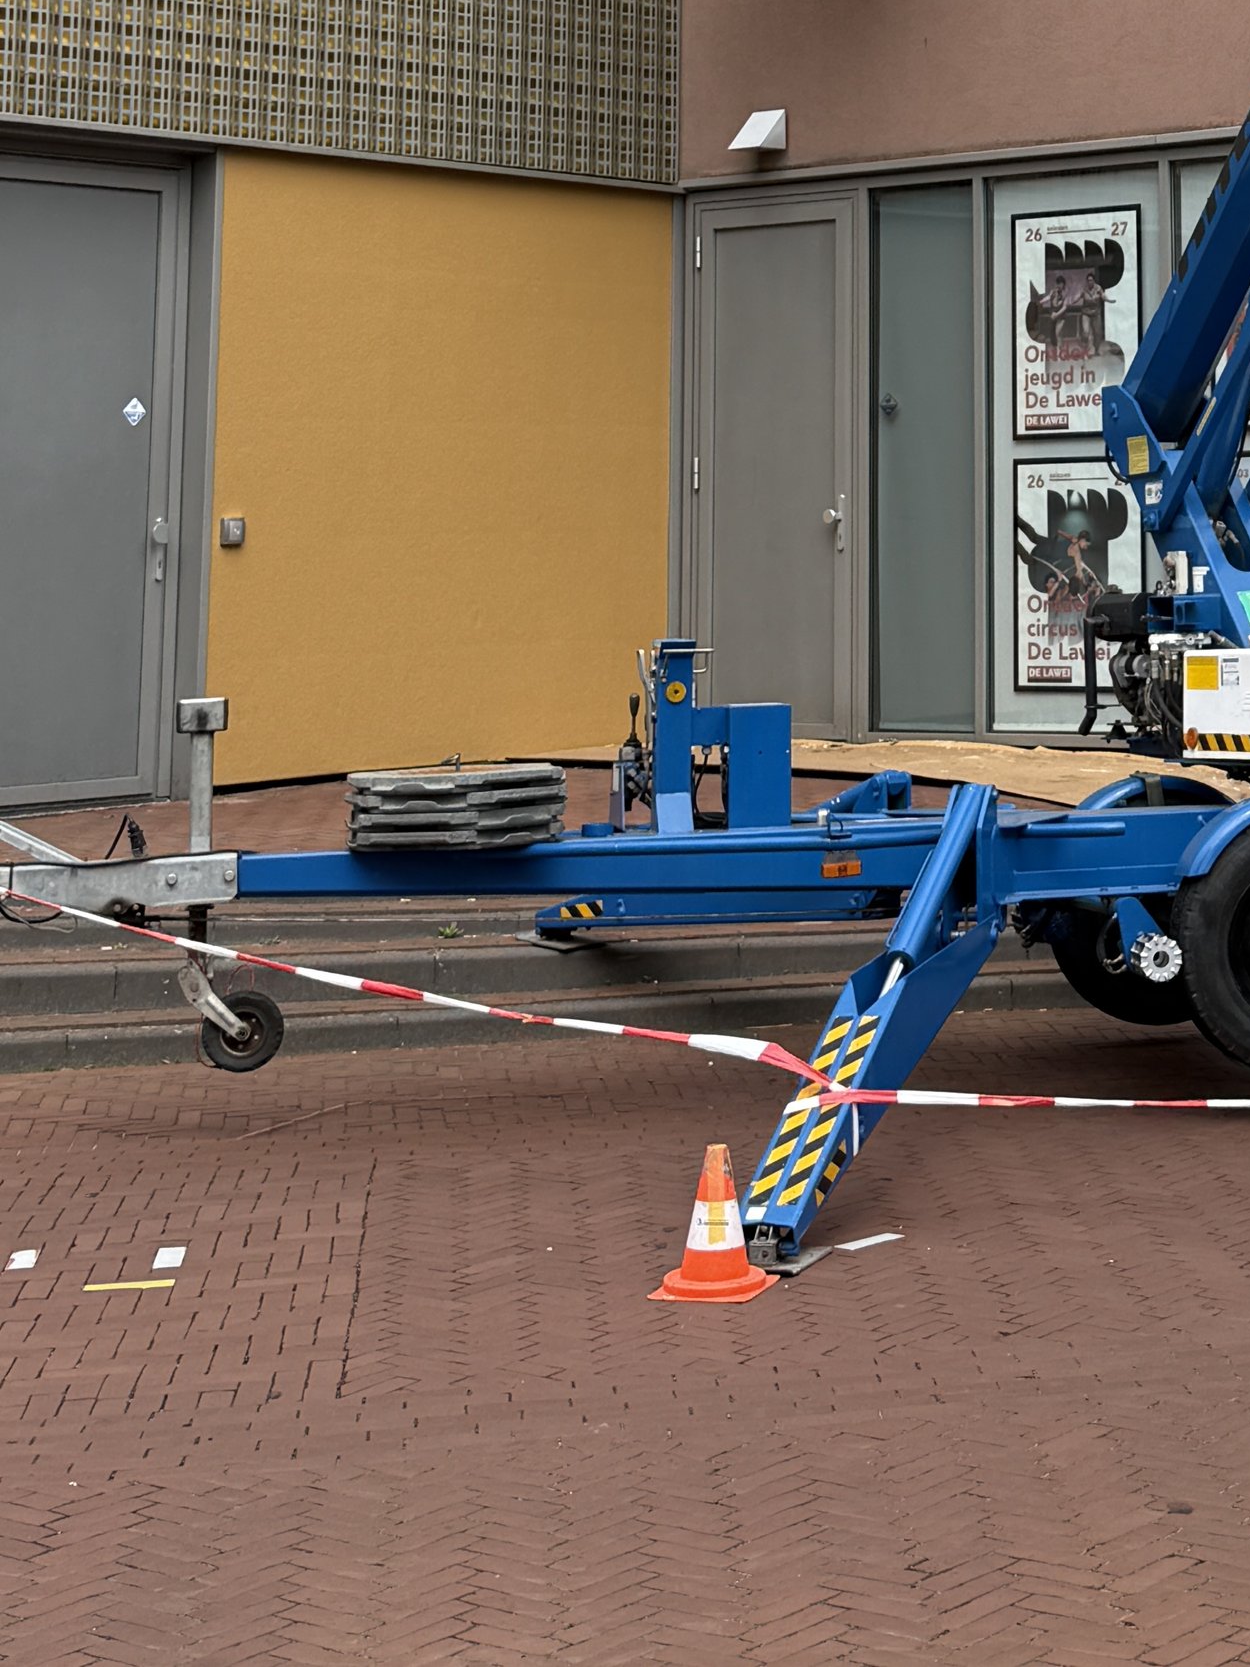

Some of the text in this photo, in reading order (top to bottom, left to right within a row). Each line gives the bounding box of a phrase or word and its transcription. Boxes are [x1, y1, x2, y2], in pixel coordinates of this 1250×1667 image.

[1025, 228, 1043, 242] 26
[1111, 222, 1128, 236] 27
[1024, 365, 1096, 391] jeugd in
[1025, 390, 1102, 409] De Lawe
[1026, 415, 1068, 426] DE LAWEI
[1027, 474, 1044, 488] 26
[1027, 618, 1078, 637] circus
[1028, 642, 1052, 660] De
[1029, 668, 1071, 677] DE LAWEI
